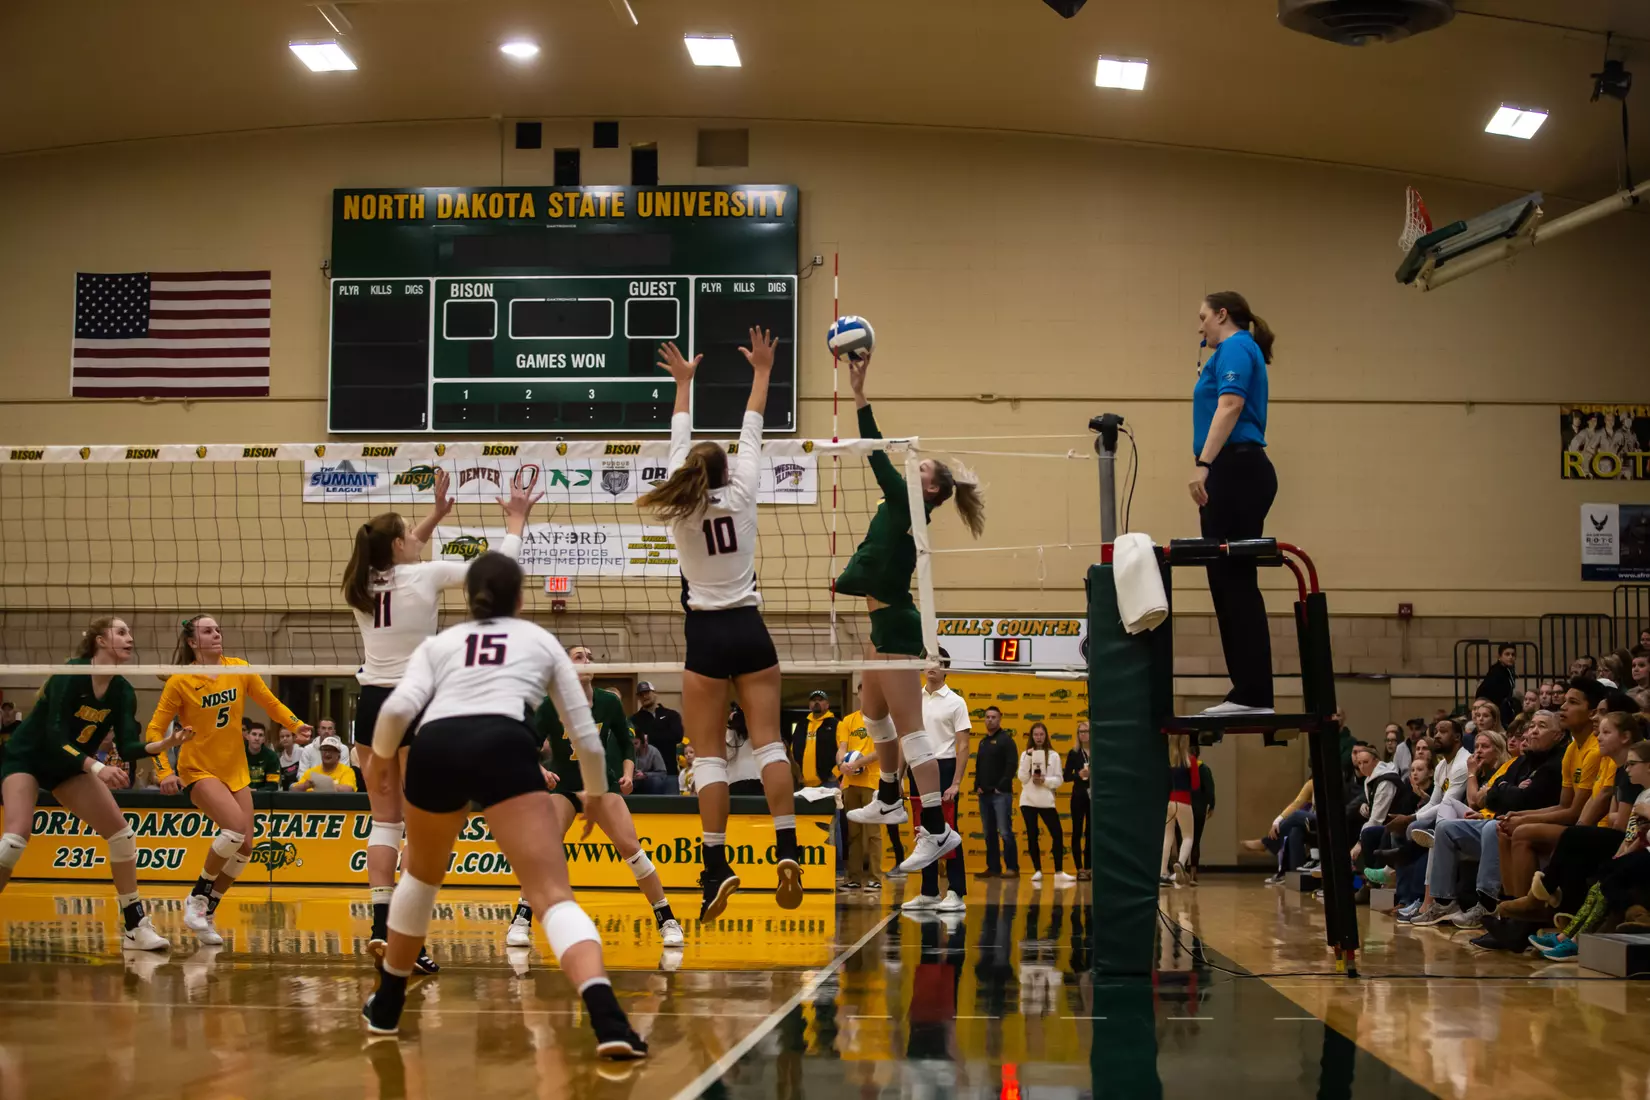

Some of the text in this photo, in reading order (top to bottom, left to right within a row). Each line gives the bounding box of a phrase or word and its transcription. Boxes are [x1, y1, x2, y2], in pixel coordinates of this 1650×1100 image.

[343, 190, 788, 221] NORTH DAKOTA STATE UNIVERSITY
[339, 284, 425, 297] PLYR KILLS DIGS
[450, 283, 494, 299] BISON
[628, 281, 677, 297] GUEST
[701, 281, 788, 294] PLYR KILLS DIGS
[515, 353, 606, 369] GAMES WON
[463, 389, 470, 400] 1
[525, 389, 533, 400] 2
[588, 389, 596, 400] 3
[651, 388, 660, 400] 4
[10, 450, 44, 460] BISON
[125, 448, 161, 460] BISON
[242, 447, 279, 458] BISON
[361, 446, 398, 457] BISON
[482, 445, 519, 456] BISON
[604, 444, 641, 455] BISON
[774, 463, 806, 476] WESTERN
[311, 471, 378, 487] SUMMIT
[393, 472, 435, 486] NDSU
[459, 467, 501, 489] DENVER
[521, 532, 607, 545] ANFORD
[701, 515, 739, 557] 10
[440, 543, 475, 556] NDSU
[519, 549, 609, 557] RTHOPEDICS
[517, 557, 623, 566] ORTS MEDICINE
[548, 576, 568, 592] EXIT
[373, 591, 392, 629] 11
[936, 619, 1082, 636] KILLS COUNTER
[463, 633, 509, 668] 15
[1000, 639, 1018, 662] 13
[200, 687, 238, 709] NDSU
[215, 706, 231, 728] 5
[31, 810, 102, 837] ORT
[253, 812, 347, 840] STATE
[135, 848, 187, 870] DSU
[249, 850, 285, 864] DSU
